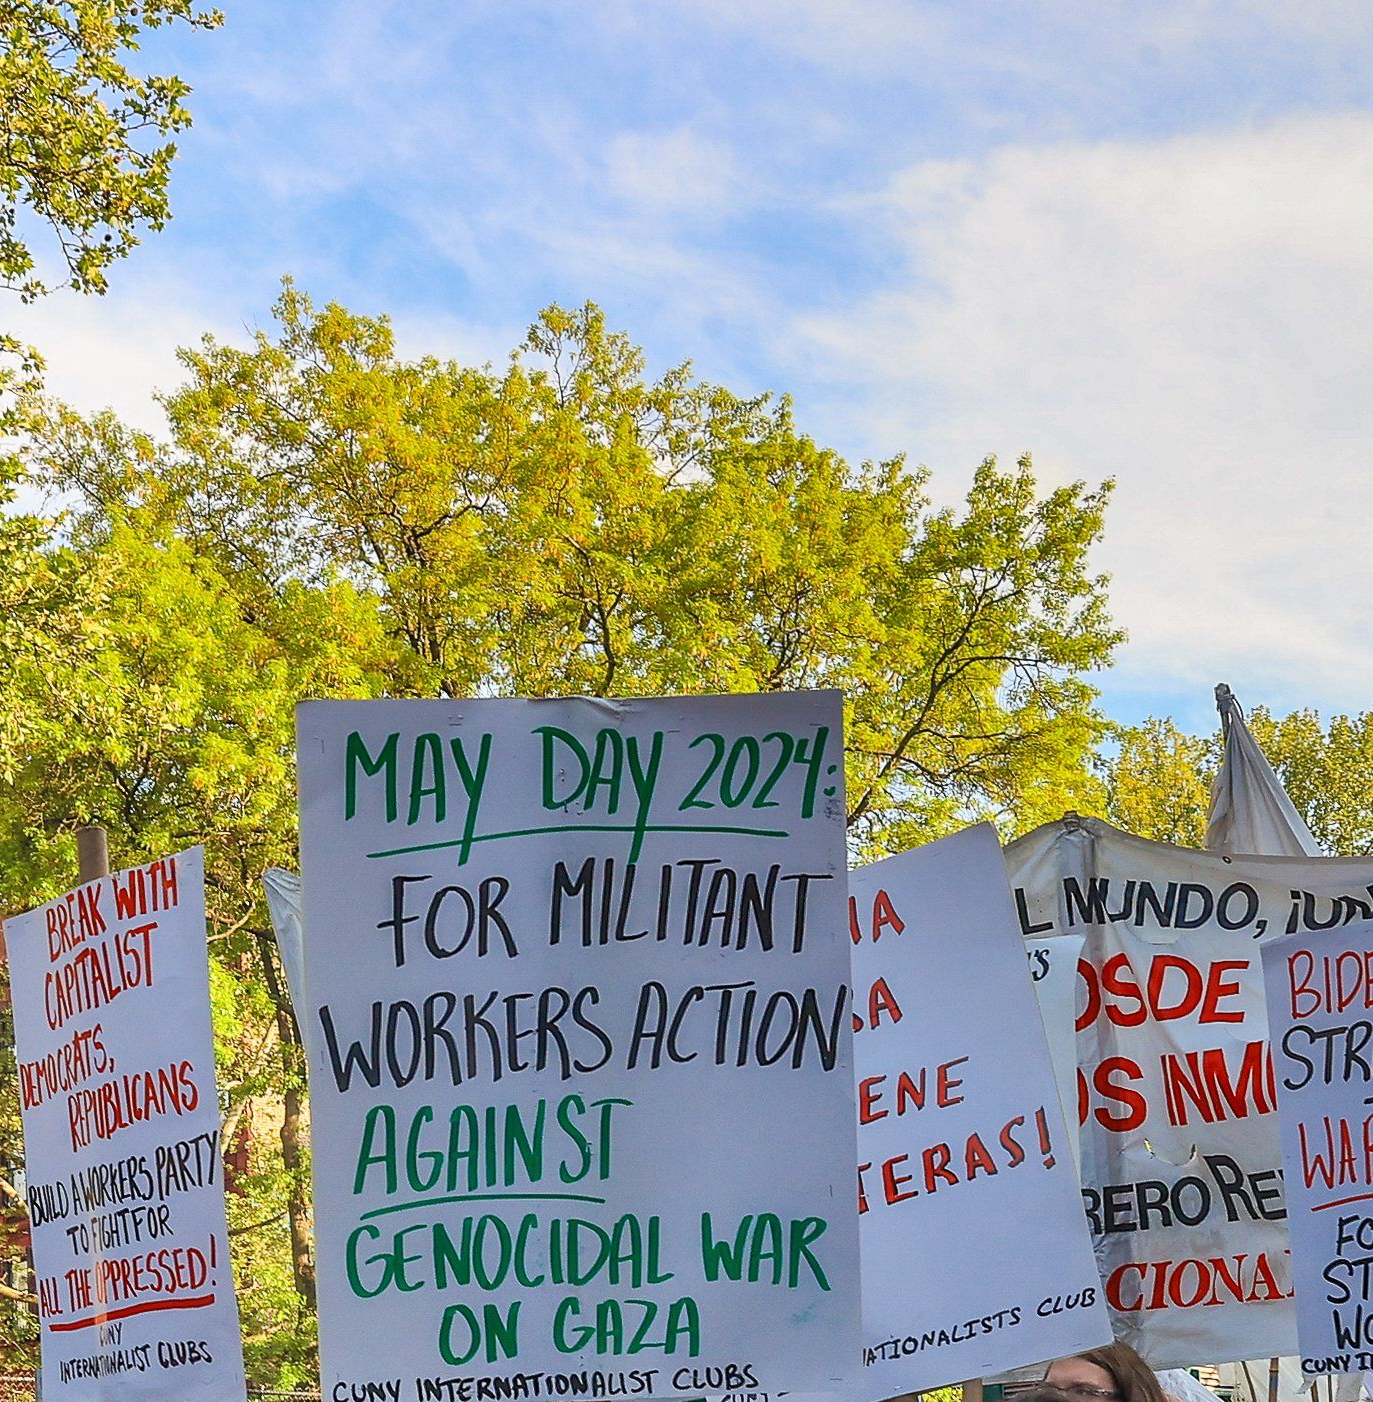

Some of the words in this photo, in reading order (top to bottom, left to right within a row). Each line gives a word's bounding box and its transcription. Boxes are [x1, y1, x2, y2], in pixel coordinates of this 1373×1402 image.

[345, 731, 492, 866] MAY
[531, 726, 667, 865] DAY
[678, 726, 836, 820] 2024:
[46, 883, 105, 962] BREAK
[114, 858, 179, 921] WITH
[376, 874, 520, 968] FOR
[549, 857, 834, 954] MILITANT
[1063, 875, 1267, 941] MUNDO,
[44, 922, 159, 1031] CAPITALIST
[21, 1024, 115, 1110] DEMOCRATS,
[318, 985, 614, 1094] WORKERS
[626, 979, 852, 1073] ACTION
[67, 1061, 199, 1153] REPUBLICANS
[353, 1095, 635, 1195] AGAINST
[29, 1181, 69, 1228] BUILD
[80, 1155, 153, 1215] WORKERS
[155, 1130, 220, 1189] PARTY
[67, 1226, 90, 1256] TO
[92, 1210, 133, 1252] FIGHT
[132, 1205, 173, 1240] FOR
[346, 1213, 674, 1298] GENOCIDAL
[701, 1212, 830, 1291] WAR
[40, 1277, 63, 1318] ALL
[65, 1268, 93, 1312] THE
[95, 1234, 217, 1306] OPPRESSED!
[1036, 1287, 1095, 1316] CLUB
[59, 1344, 151, 1384] INTERNATIONALIST
[157, 1340, 213, 1368] CLUBS
[439, 1300, 522, 1366] ON
[553, 1297, 700, 1357] GAZA
[1301, 1353, 1350, 1375] CUNY
[416, 1368, 659, 1402] INTERNATIONALIST
[672, 1364, 759, 1391] CLUBS
